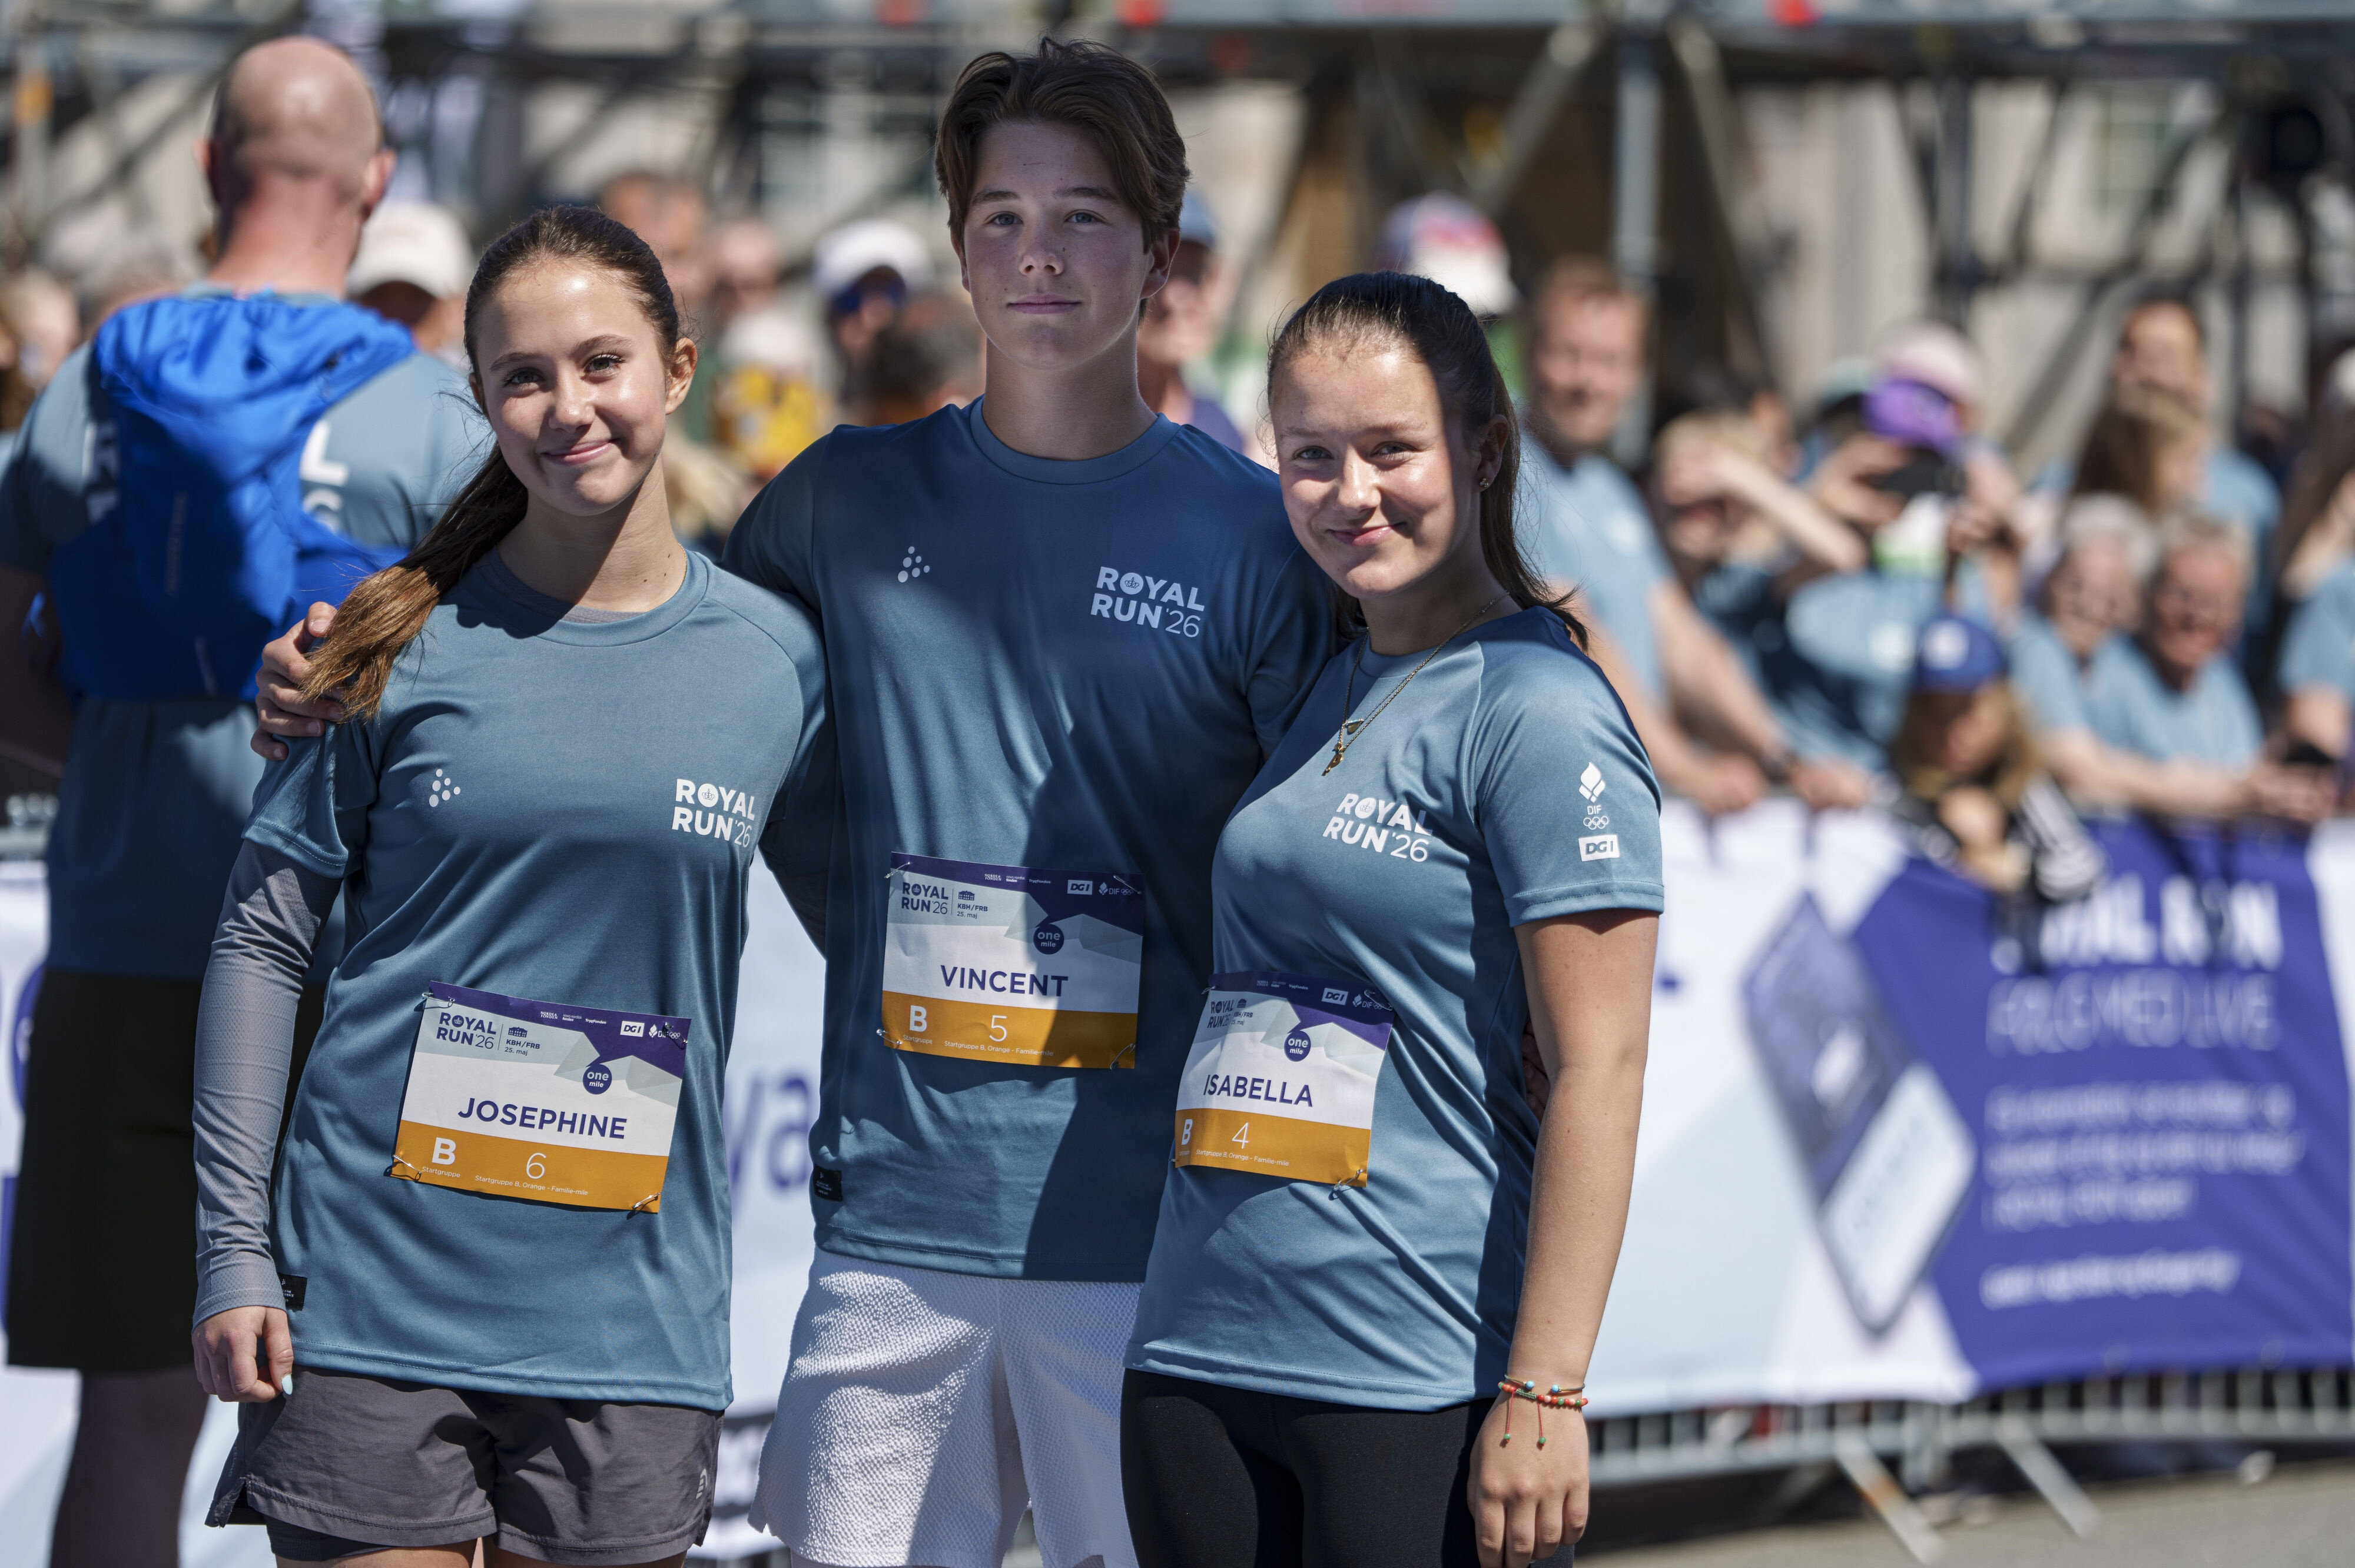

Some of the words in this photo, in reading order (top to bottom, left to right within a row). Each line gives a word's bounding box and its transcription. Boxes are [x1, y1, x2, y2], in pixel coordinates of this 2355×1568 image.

[1096, 566, 1205, 612] ROYAL
[675, 779, 755, 820] ROYAL
[1336, 793, 1432, 836] ROYAL
[1587, 805, 1602, 815] DIF
[1586, 841, 1614, 855] DGI
[902, 882, 948, 900] ROYAL
[1070, 883, 1090, 892] DGI
[1037, 932, 1060, 941] one
[940, 965, 1069, 996] VINCENT
[1325, 992, 1345, 1001] DGI
[1210, 1000, 1234, 1014] ROYAL
[439, 1012, 496, 1035] ROYAL
[910, 1005, 927, 1032] B
[623, 1025, 641, 1034] DGI
[989, 1015, 1007, 1042] 5
[903, 1035, 933, 1044] Startgruppe
[944, 1041, 979, 1051] Startgruppe
[1288, 1038, 1308, 1048] one
[587, 1071, 609, 1081] one
[1203, 1074, 1312, 1107] ISABELLA
[458, 1098, 627, 1139] JOSEPHINE
[1181, 1119, 1193, 1145] B
[1232, 1122, 1249, 1149] 4
[432, 1137, 456, 1165] B
[1196, 1149, 1222, 1158] Startgruppe
[1254, 1156, 1289, 1167] Familie-mile
[422, 1166, 460, 1178] Startgruppe
[526, 1152, 546, 1179] 6
[475, 1175, 513, 1186] Startgruppe
[551, 1187, 588, 1195] Familie-mile
